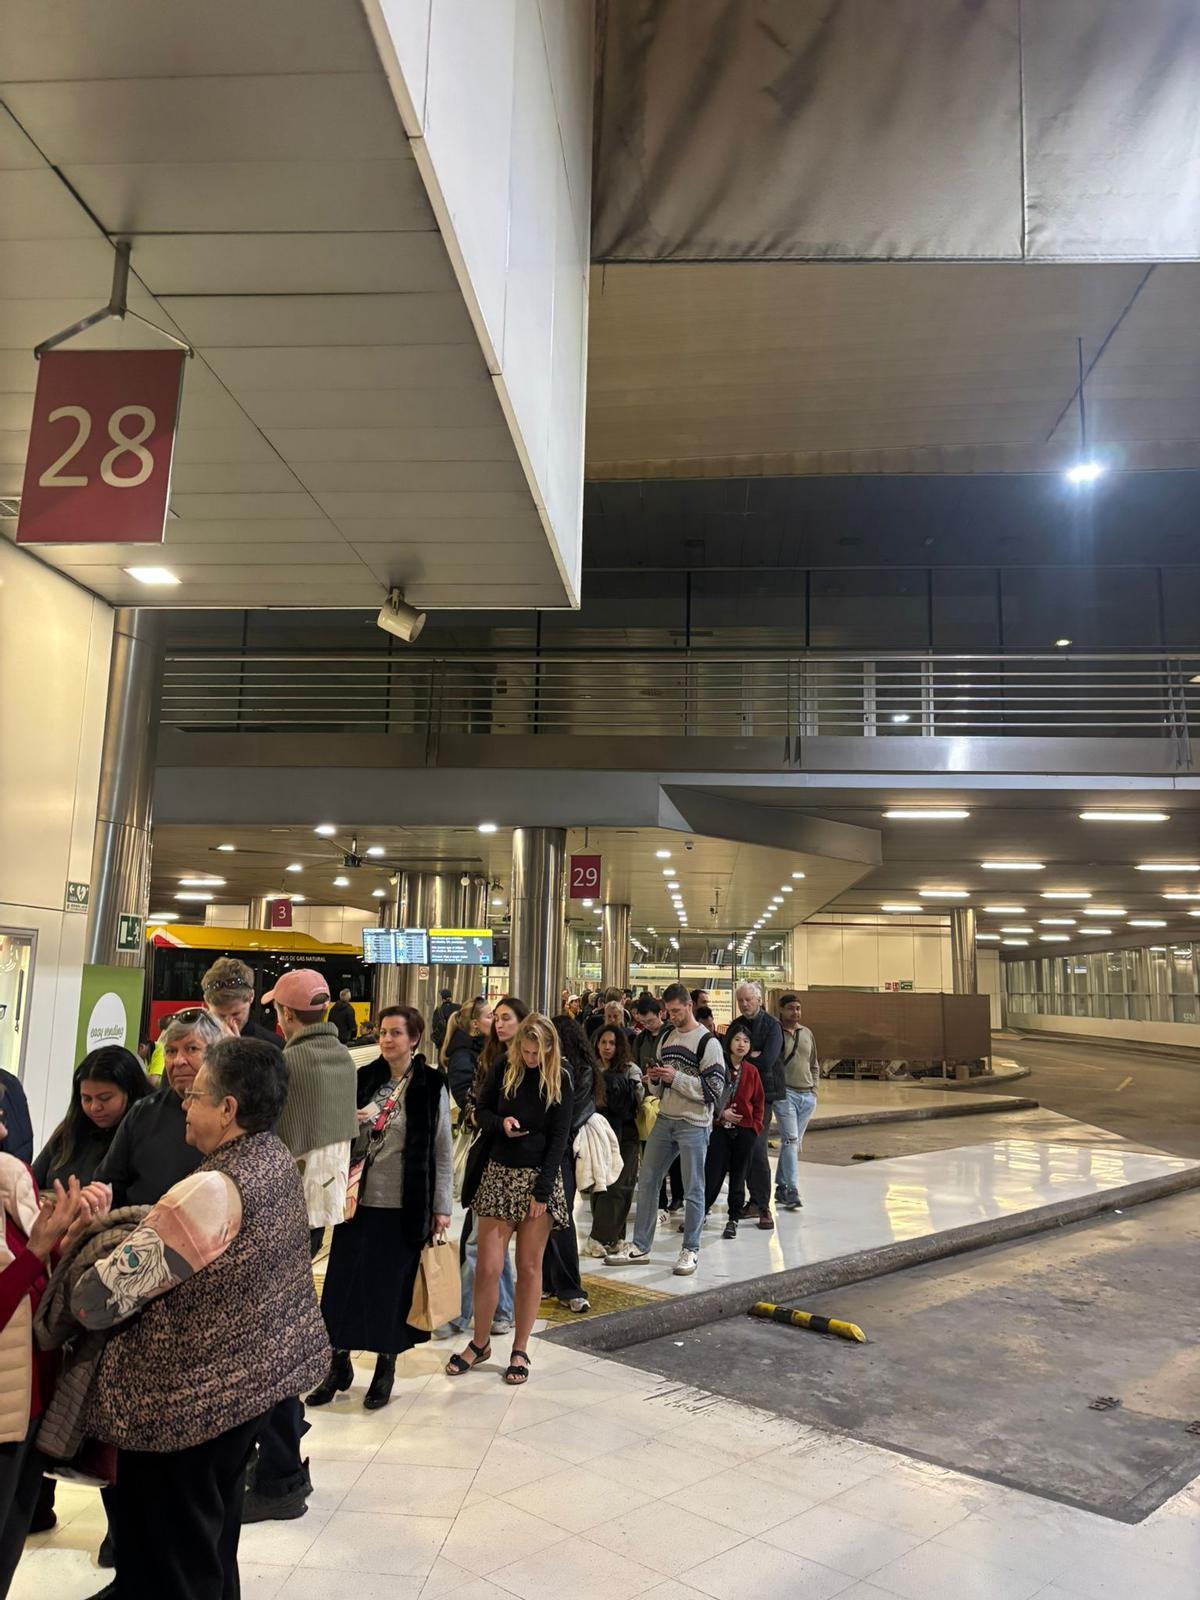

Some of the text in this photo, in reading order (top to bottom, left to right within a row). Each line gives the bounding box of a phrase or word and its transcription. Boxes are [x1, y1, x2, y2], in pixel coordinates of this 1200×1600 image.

[39, 405, 156, 488] 28
[573, 868, 598, 886] 29
[278, 906, 287, 919] 3
[90, 1024, 124, 1040] easy vending
